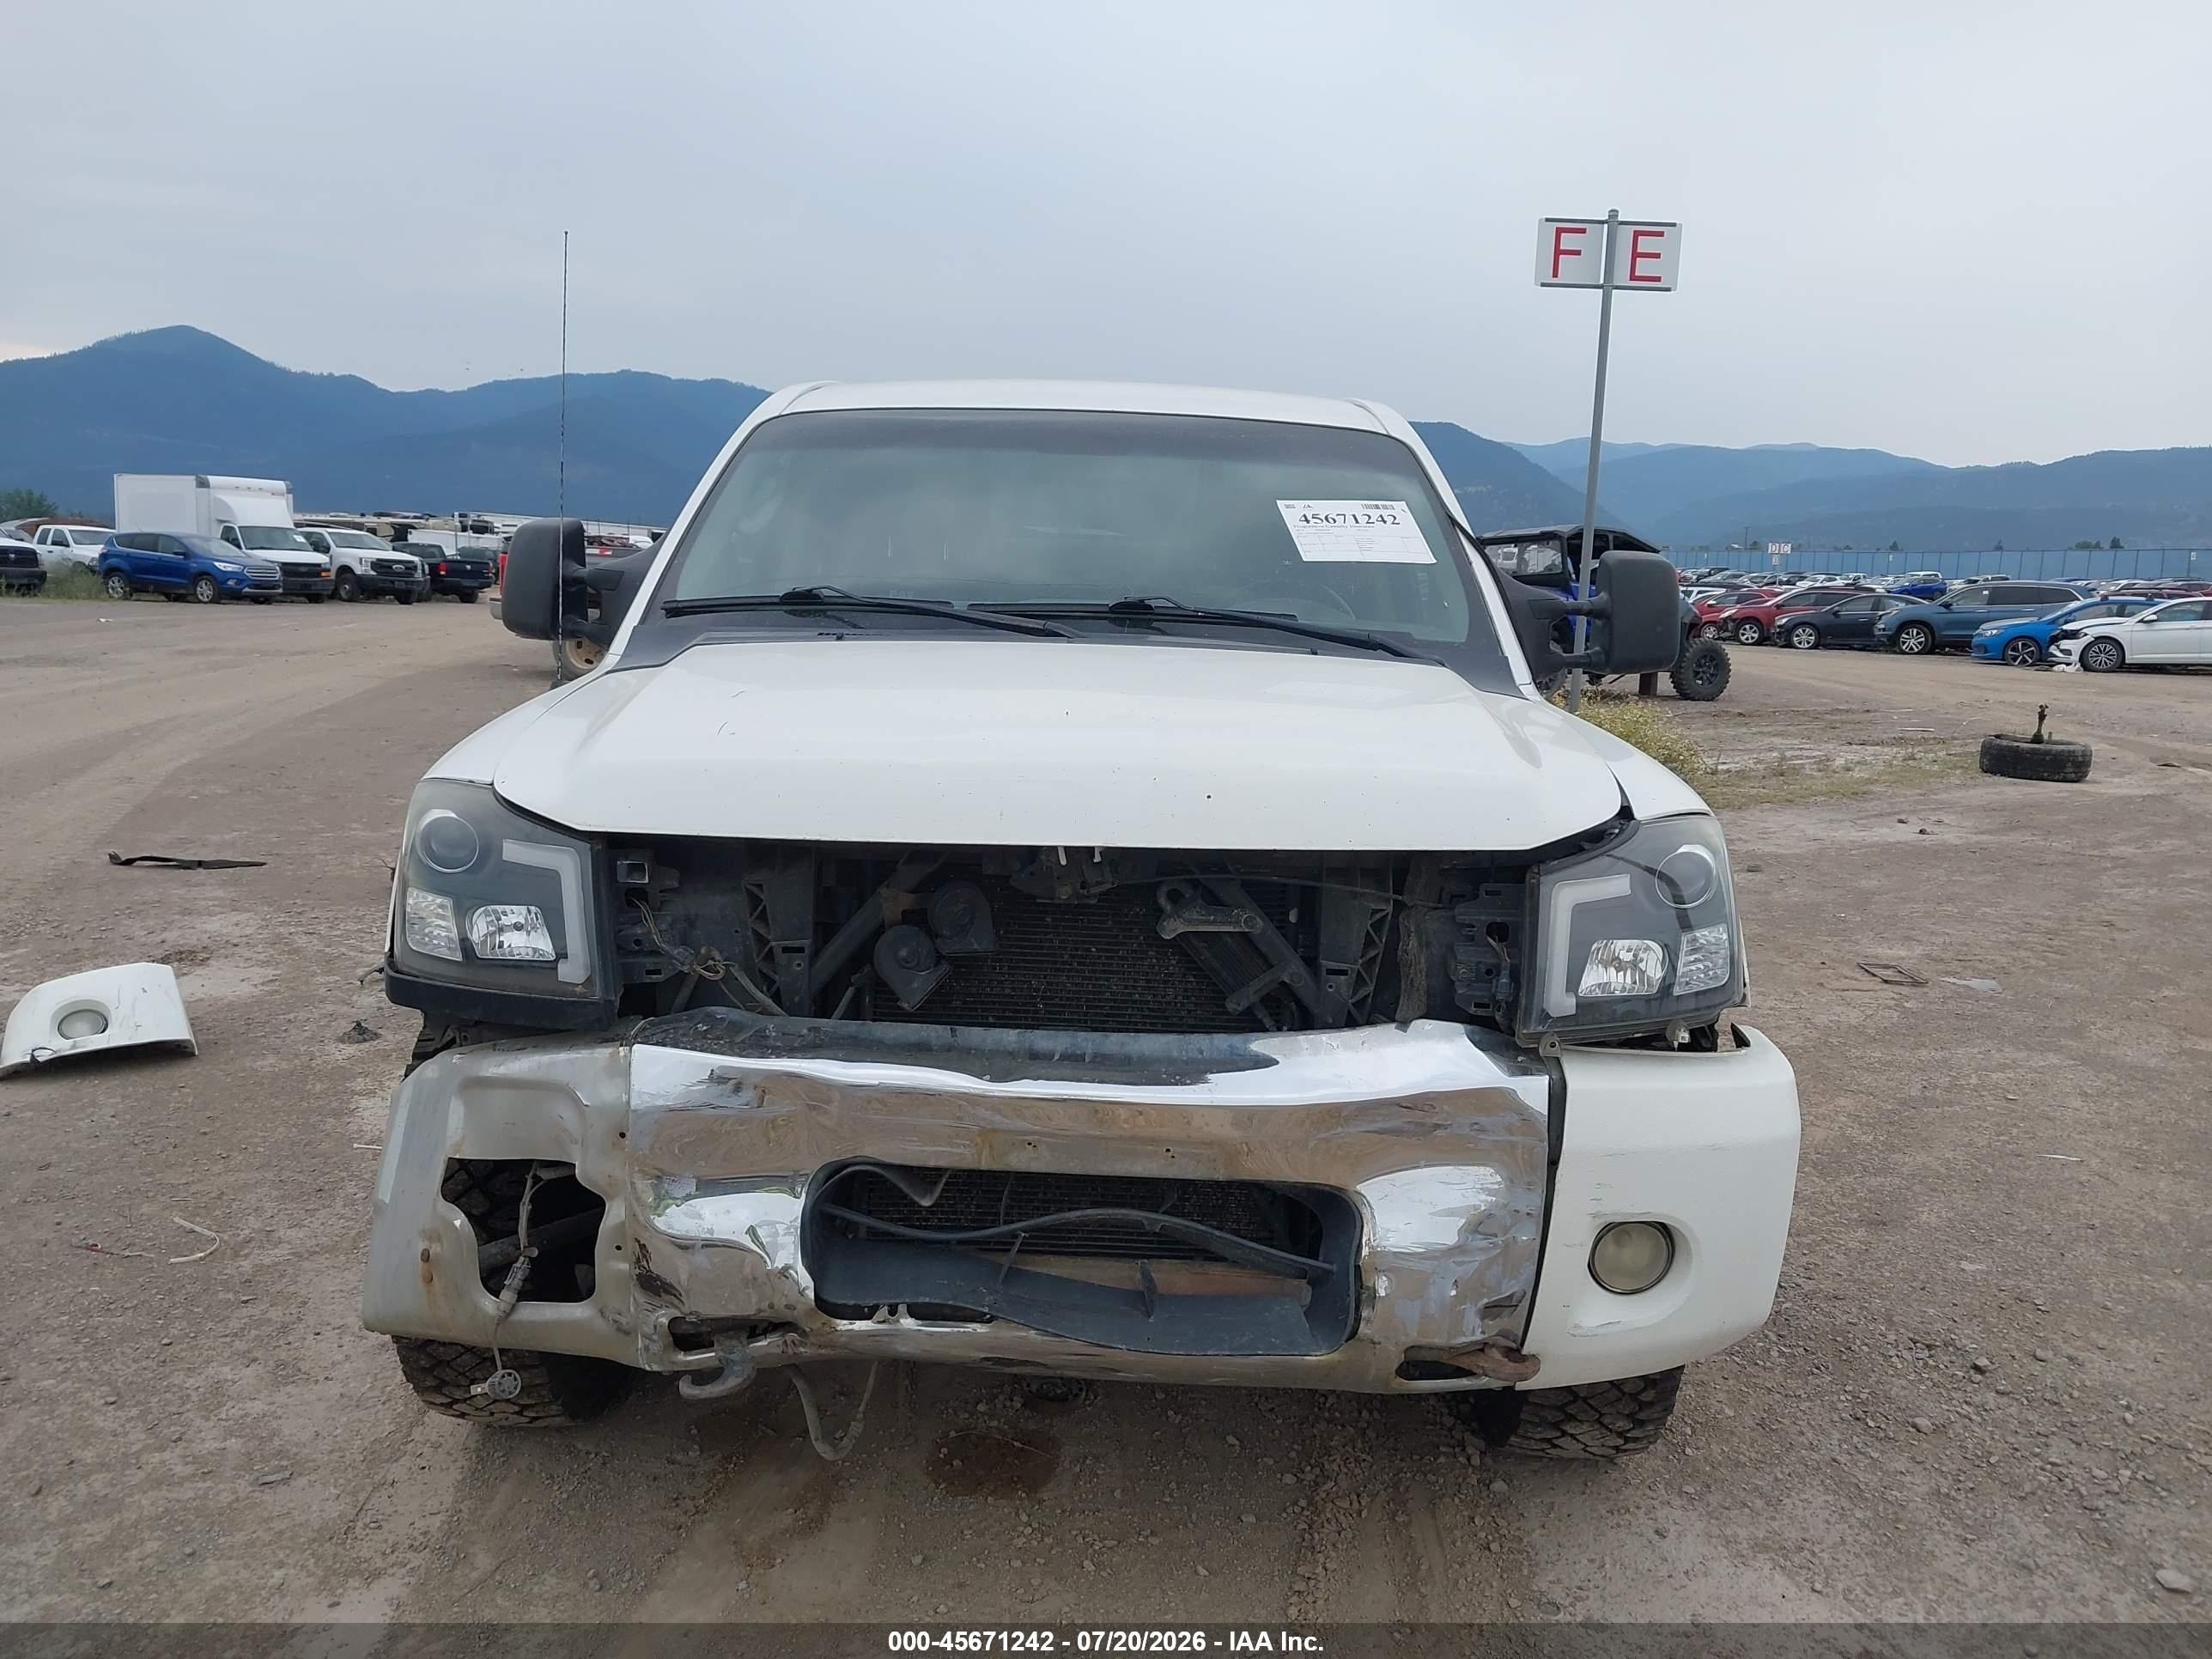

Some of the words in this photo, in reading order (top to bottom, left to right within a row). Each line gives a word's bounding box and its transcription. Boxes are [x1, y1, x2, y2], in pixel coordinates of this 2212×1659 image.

[1552, 227, 1587, 278] F
[1629, 230, 1665, 283] E
[1298, 513, 1401, 526] 45671242
[1771, 544, 1778, 553] D
[1783, 544, 1790, 553] C
